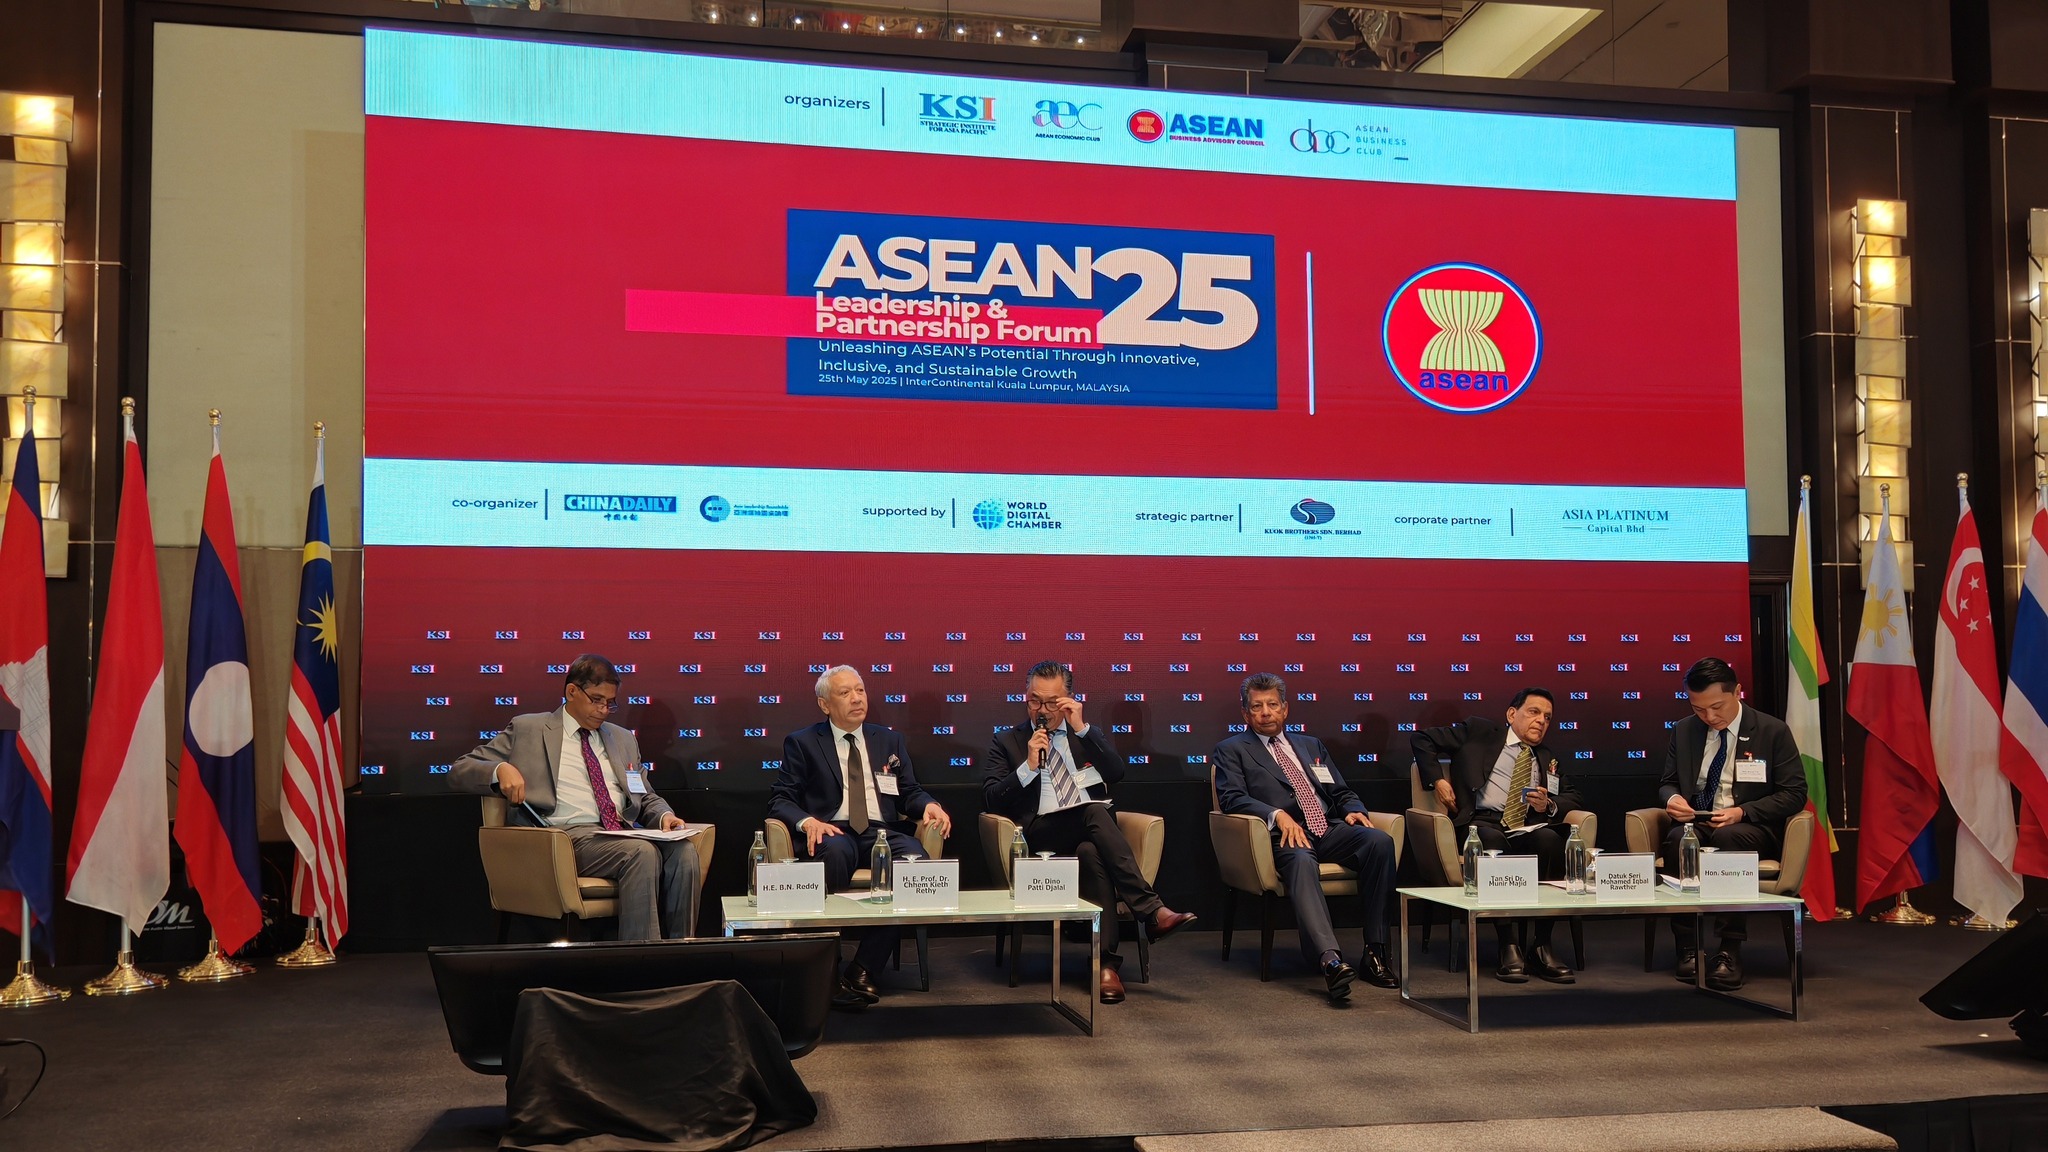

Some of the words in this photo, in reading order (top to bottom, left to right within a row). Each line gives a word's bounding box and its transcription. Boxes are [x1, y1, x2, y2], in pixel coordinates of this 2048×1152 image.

[785, 95, 870, 110] organizers
[919, 92, 996, 121] KSI
[920, 120, 959, 129] STRATEGIC
[960, 122, 996, 131] INSTITUTE
[1169, 113, 1263, 139] ASEAN
[1356, 125, 1389, 133] ASEAN
[1170, 135, 1202, 143] BUSINESS
[1203, 137, 1236, 145] ADVISORY
[1236, 139, 1265, 147] COUNCIL
[1356, 136, 1407, 146] BUSINESS
[1356, 148, 1382, 156] CLUB
[812, 233, 1093, 300] ASEAN
[1091, 246, 1259, 351] 25
[815, 290, 981, 322] Leadership
[986, 298, 1008, 320] &
[815, 312, 990, 344] Partnership
[997, 319, 1092, 344] Forum
[818, 340, 907, 358] Unleashing
[981, 346, 1048, 361] Potential
[1052, 348, 1116, 365] Through
[1120, 351, 1200, 368] Innovative,
[818, 358, 891, 375] Inclusive,
[895, 362, 924, 375] and
[929, 363, 1018, 378] Sustainable
[1021, 367, 1077, 380] Growth
[818, 374, 843, 384] 25th
[846, 374, 869, 386] May
[871, 376, 898, 385] 2025
[906, 377, 994, 389] InterContinental
[996, 380, 1026, 390] Kuala
[1030, 382, 1074, 392] Lumpur,
[1076, 383, 1130, 393] MALAYSIA
[1419, 372, 1509, 391] asean
[452, 497, 538, 510] co-organizer
[1007, 502, 1047, 510] WORLD
[862, 507, 927, 518] supported
[931, 507, 946, 518] by
[1007, 511, 1051, 520] DIGITAL
[1135, 512, 1187, 523] strategic
[1190, 512, 1234, 523] partner
[1562, 509, 1594, 520] ASIA
[1597, 510, 1670, 521] PLATINUM
[1007, 520, 1062, 530] CHAMBER
[1394, 516, 1448, 526] corporate
[1451, 516, 1492, 526] partner
[1587, 524, 1623, 534] Capital
[1626, 524, 1645, 534] Bhd
[426, 630, 450, 640] KSI
[562, 630, 585, 640] KSI
[694, 631, 716, 640] KSI
[822, 631, 844, 641] KSI
[884, 631, 906, 641] KSI
[1006, 632, 1026, 641] KSI
[1066, 632, 1085, 641] KSI
[1182, 632, 1201, 641] KSI
[1296, 633, 1315, 642] KSI
[1408, 633, 1427, 642] KSI
[1516, 633, 1533, 642] KSI
[1568, 634, 1586, 642] KSI
[1672, 634, 1691, 642] KSI
[1724, 634, 1742, 642] KSI
[410, 664, 435, 674] KSI
[480, 664, 503, 674] KSI
[678, 663, 702, 673] KSI
[744, 663, 766, 673] KSI
[870, 663, 892, 673] KSI
[932, 663, 953, 673] KSI
[1110, 663, 1131, 672] KSI
[1226, 663, 1247, 672] KSI
[1284, 663, 1304, 672] KSI
[1396, 663, 1415, 672] KSI
[1504, 663, 1523, 672] KSI
[1610, 663, 1628, 672] KSI
[628, 695, 650, 705] KSI
[694, 695, 716, 705] KSI
[758, 695, 781, 704] KSI
[884, 694, 908, 703] KSI
[946, 693, 968, 703] KSI
[1124, 693, 1145, 702] KSI
[1298, 692, 1317, 702] KSI
[1410, 692, 1428, 701] KSI
[1570, 691, 1589, 700] KSI
[1622, 691, 1641, 700] KSI
[426, 696, 450, 706] KSI
[494, 696, 518, 706] KSI
[932, 725, 955, 735] KSI
[1112, 724, 1133, 733] KSI
[1170, 724, 1191, 733] KSI
[1342, 723, 1362, 732] KSI
[1560, 721, 1579, 730] KSI
[410, 730, 435, 741] KSI
[678, 728, 702, 738] KSI
[744, 727, 767, 737] KSI
[1128, 755, 1150, 764] KSI
[1358, 753, 1379, 762] KSI
[1574, 750, 1595, 759] KSI
[1628, 750, 1647, 759] KSI
[698, 761, 721, 771] KSI
[950, 757, 972, 767] KSI
